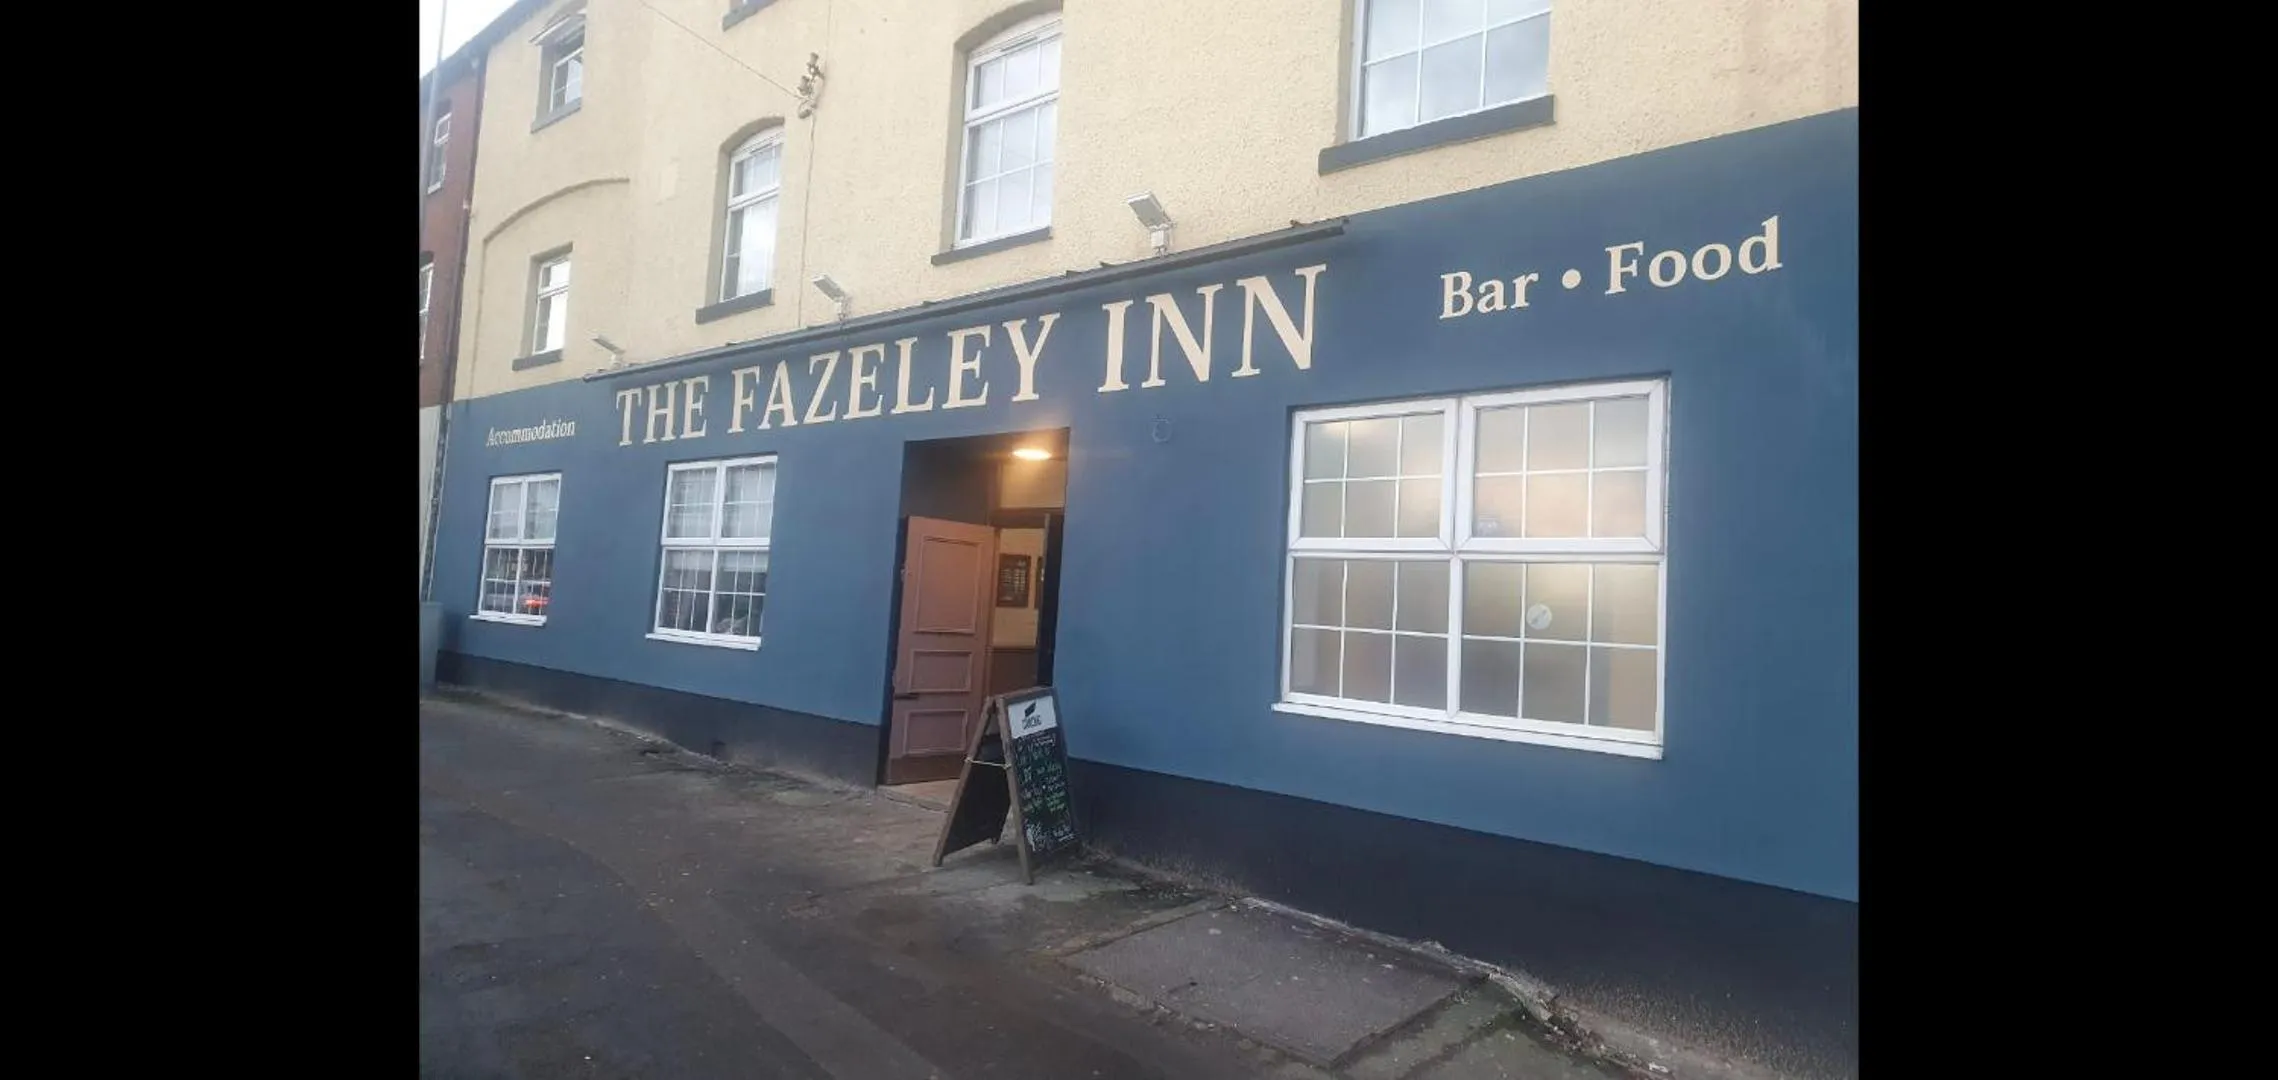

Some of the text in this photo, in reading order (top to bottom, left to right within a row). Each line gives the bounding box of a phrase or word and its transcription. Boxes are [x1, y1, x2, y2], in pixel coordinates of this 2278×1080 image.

[1439, 215, 1783, 320] Bar Food
[615, 264, 1327, 447] THE FAZELEY INN
[486, 417, 576, 447] Accommodation
